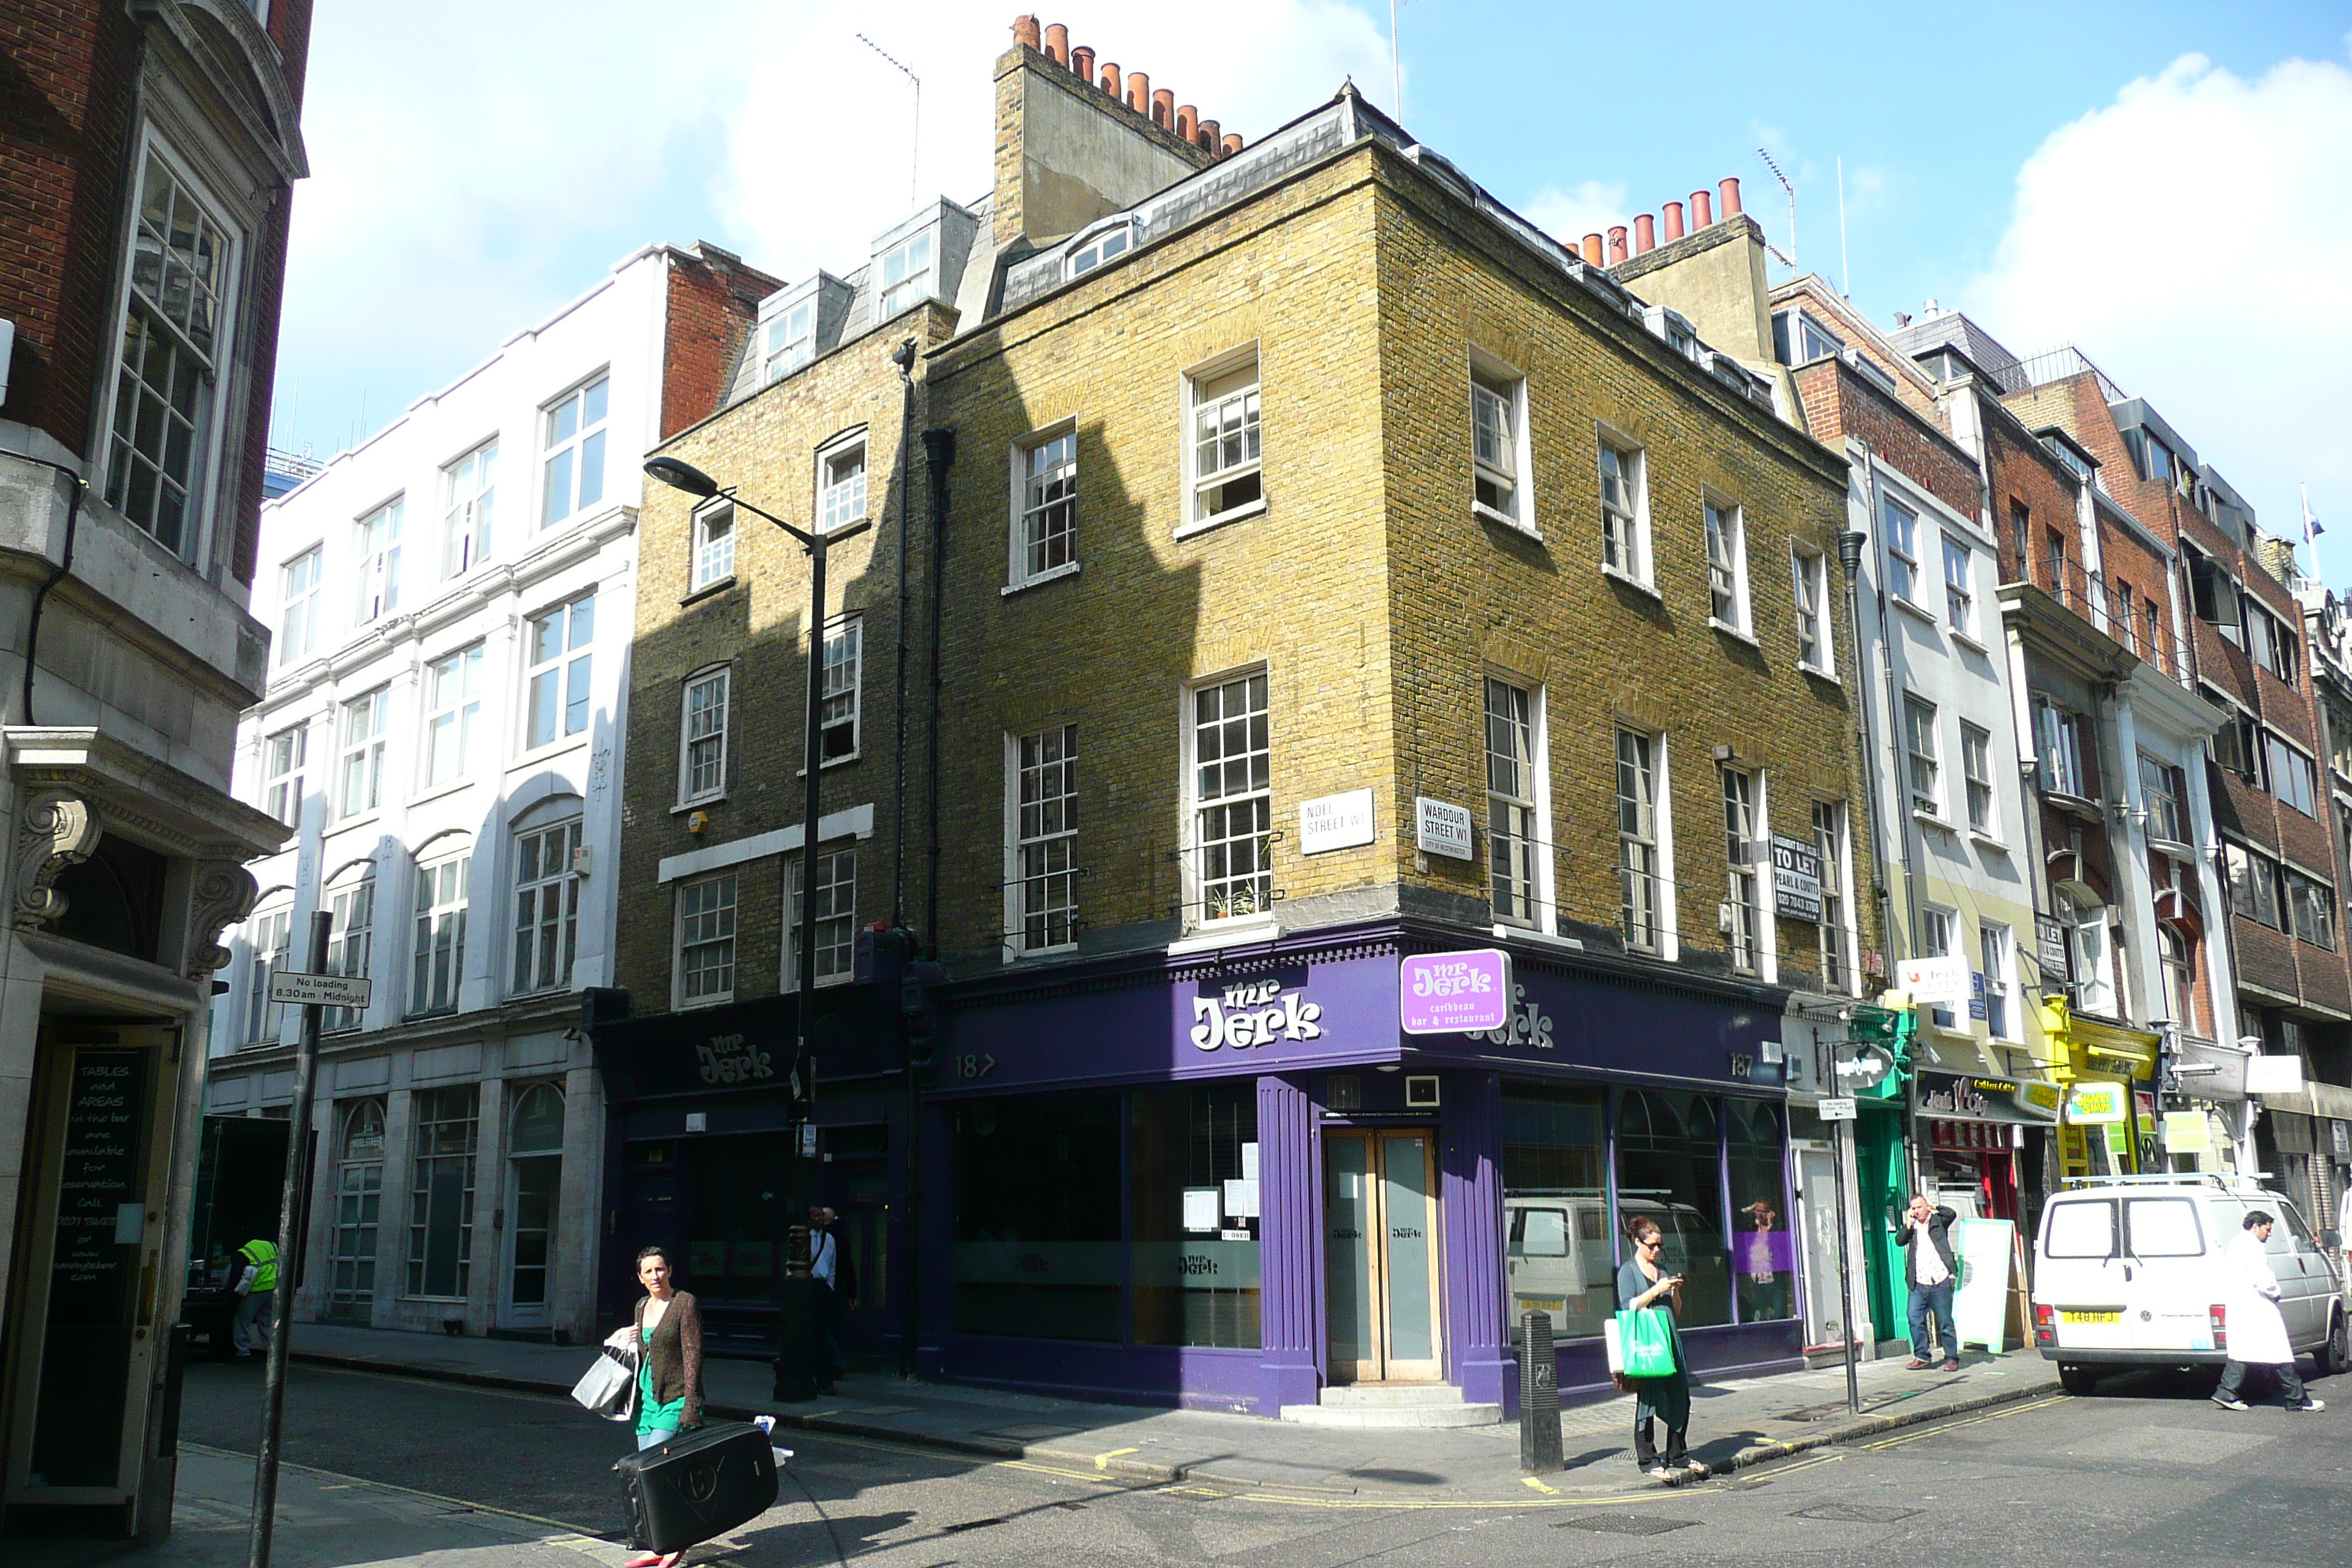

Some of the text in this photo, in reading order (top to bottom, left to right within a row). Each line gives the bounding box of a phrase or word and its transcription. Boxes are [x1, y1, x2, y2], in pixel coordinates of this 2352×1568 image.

[1307, 802, 1333, 818] NOEL
[1424, 803, 1465, 826] WARDOUR
[1308, 813, 1365, 834] STREET W1
[1425, 820, 1467, 842] STREET W1
[1440, 844, 1466, 855] WESTMINSTER
[1775, 848, 1816, 876] TO LET
[1775, 872, 1819, 896] PEARL & COUTTS
[1777, 892, 1789, 905] 020
[2046, 926, 2061, 943] LET
[296, 978, 349, 991] No loading
[1413, 967, 1492, 997] Jerk
[323, 992, 365, 1003] Midnight
[1430, 1002, 1475, 1013] caribbean
[1190, 992, 1322, 1052] Jerk
[1411, 1011, 1495, 1026] bar & restaurant
[695, 1044, 774, 1084] Jerk
[1730, 1052, 1754, 1077] 187
[80, 1066, 130, 1077] TABLES
[89, 1080, 116, 1091] and
[78, 1096, 124, 1107] AREAS
[2081, 1103, 2112, 1115] SNAPS
[70, 1112, 130, 1123] in the bar
[84, 1131, 112, 1139] are
[67, 1145, 125, 1156] available
[81, 1161, 106, 1175] for
[62, 1177, 127, 1189] eservation
[77, 1197, 103, 1208] Call
[77, 1235, 92, 1244] or
[70, 1273, 97, 1282] com
